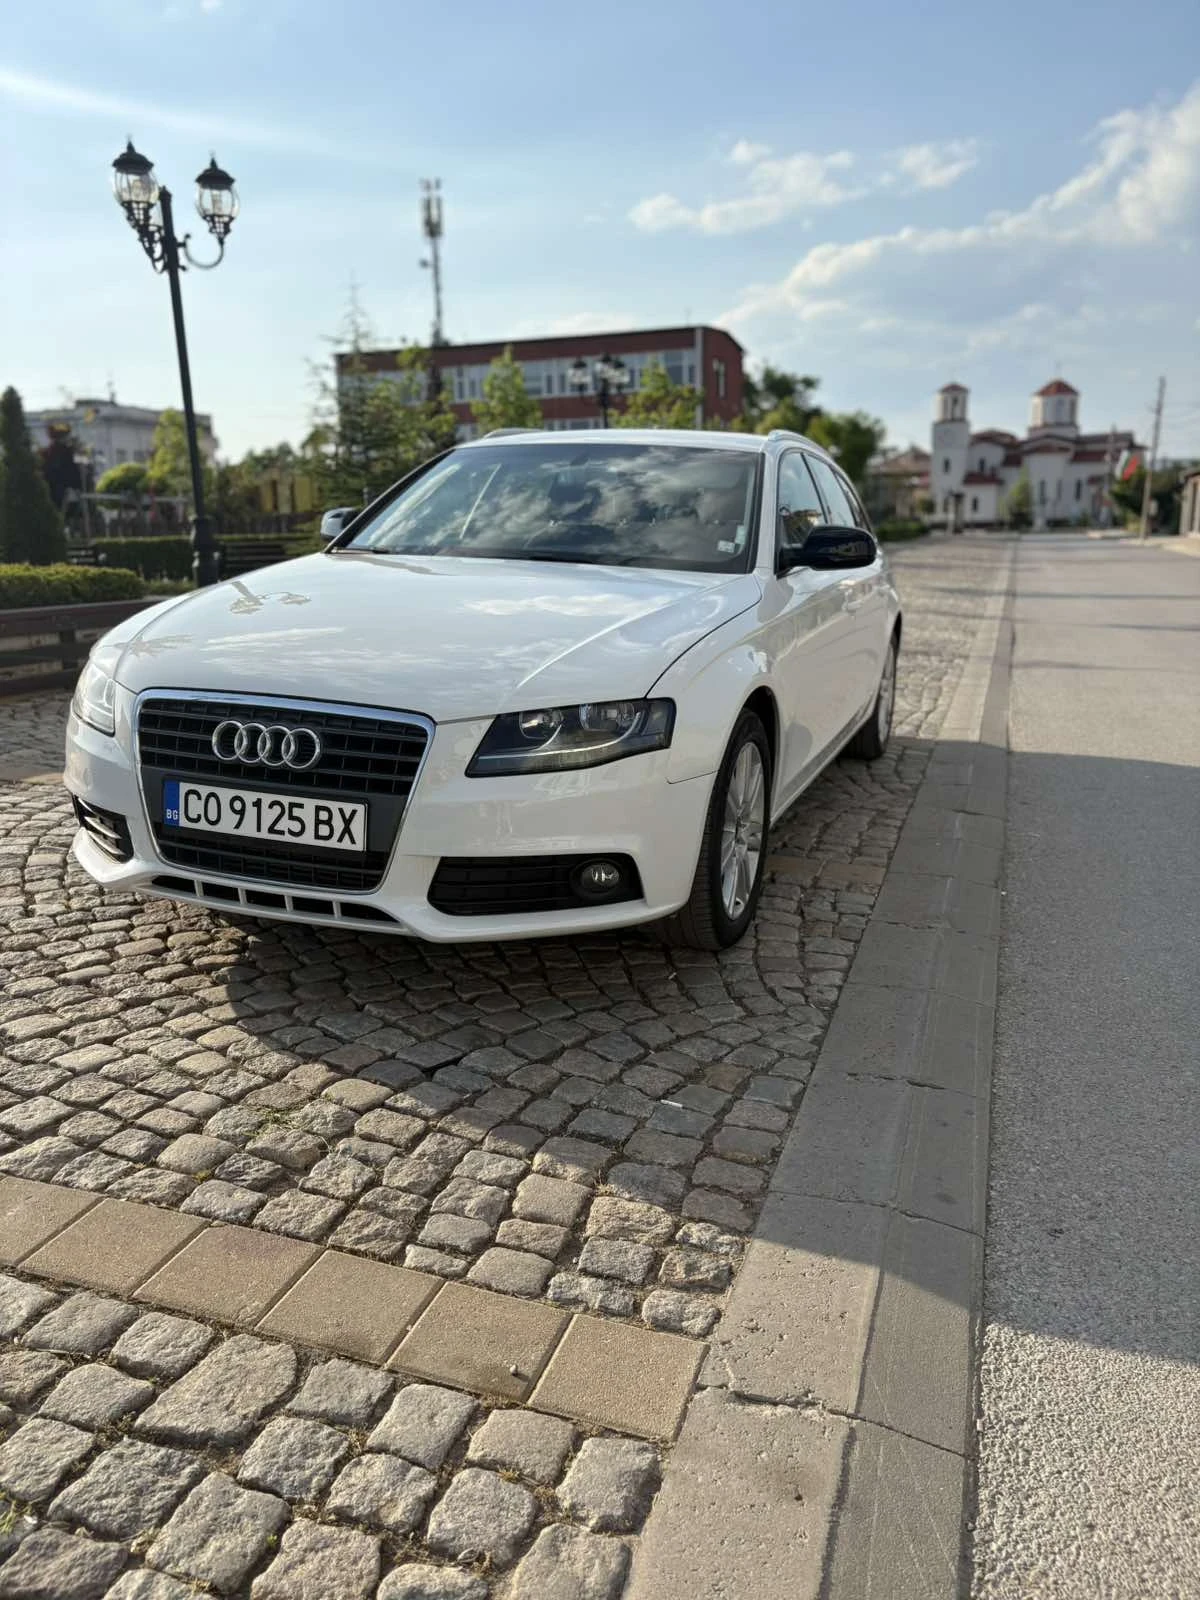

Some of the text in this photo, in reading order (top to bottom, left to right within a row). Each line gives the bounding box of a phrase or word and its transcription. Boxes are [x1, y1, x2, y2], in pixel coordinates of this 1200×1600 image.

[166, 809, 178, 820] BG
[229, 795, 306, 838] 9125
[314, 805, 358, 845] BX
